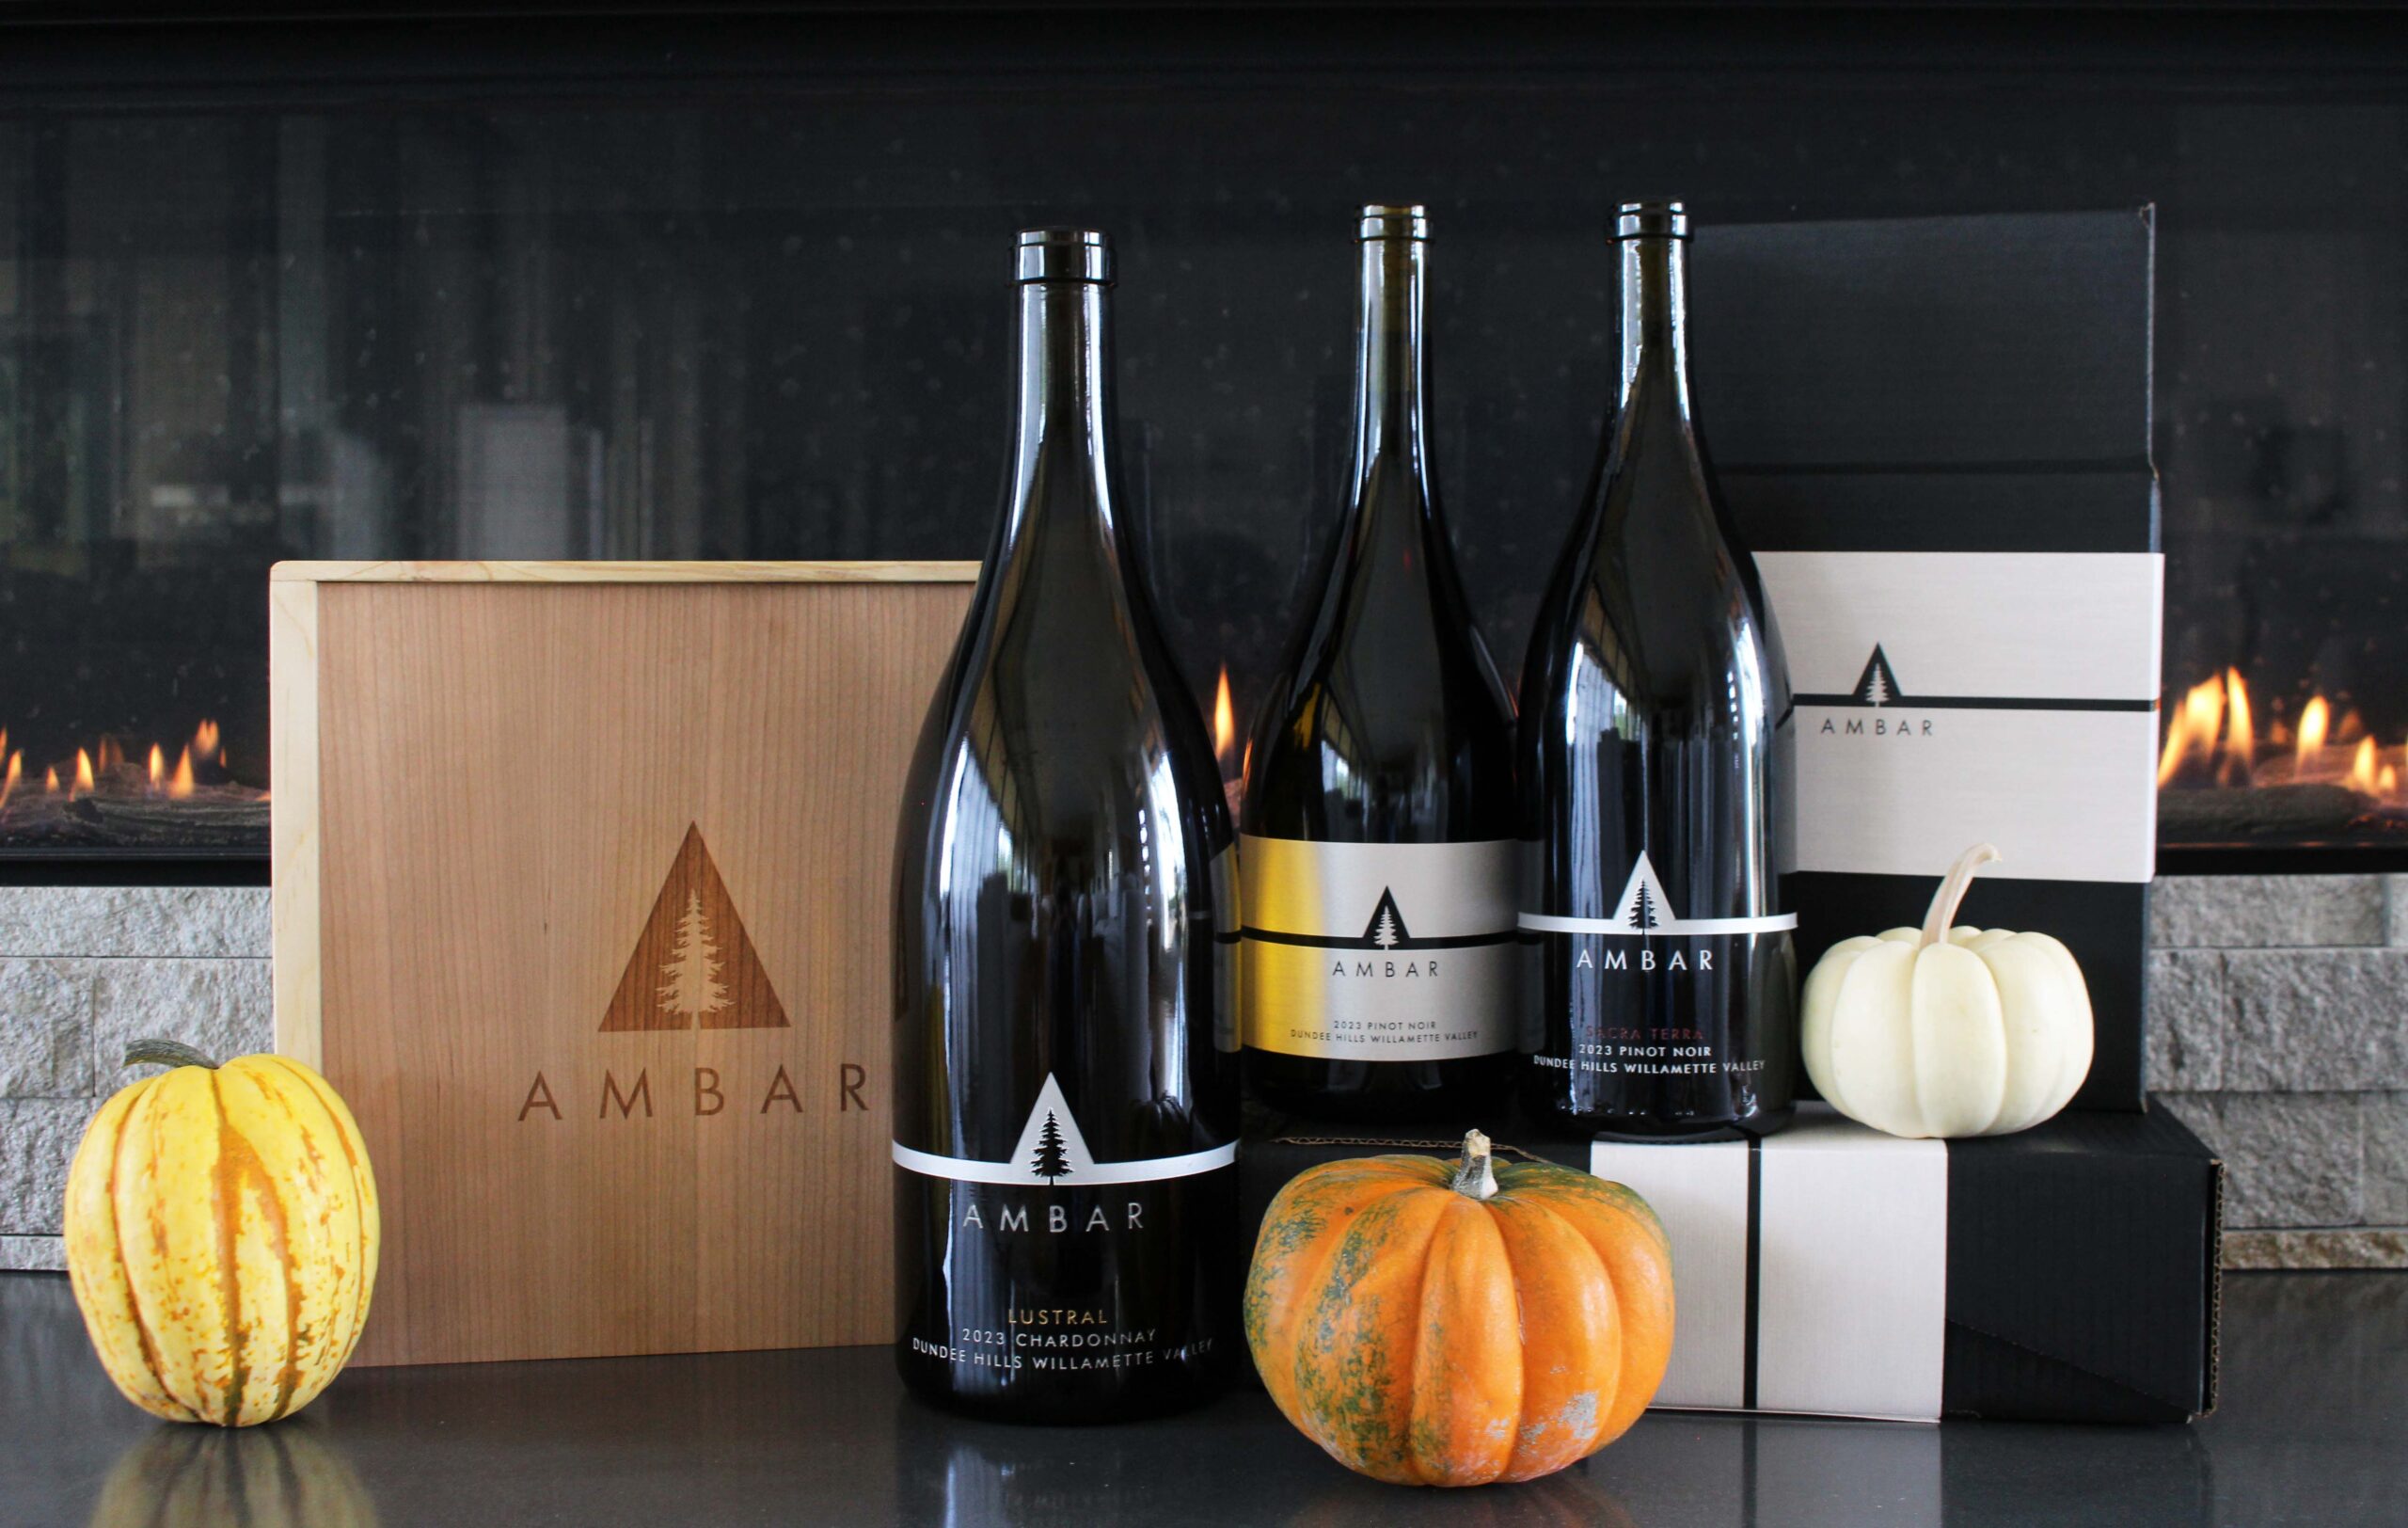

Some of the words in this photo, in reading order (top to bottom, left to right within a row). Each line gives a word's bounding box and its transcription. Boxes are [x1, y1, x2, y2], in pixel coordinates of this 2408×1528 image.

[1821, 718, 1933, 736] AMBAR
[1332, 960, 1438, 978] AMBAR
[1576, 949, 1714, 971] AMBAR
[1334, 1020, 1362, 1029] 2023
[1367, 1021, 1403, 1030] PINOT
[1408, 1020, 1436, 1029] NOIR
[1649, 1027, 1703, 1041] TERRA
[1291, 1029, 1331, 1041] DUNDEE
[1336, 1032, 1366, 1043] HILLS
[1370, 1033, 1440, 1043] WILLAMETTE
[1445, 1030, 1479, 1041] VALLEY
[1578, 1043, 1612, 1056] 2023
[1620, 1046, 1665, 1058] PINOT
[1672, 1046, 1712, 1058] NOIR
[1533, 1055, 1576, 1070] DUNDEE
[1580, 1060, 1618, 1073] HILLS
[1624, 1063, 1717, 1074] WILLAMETTE
[1723, 1059, 1766, 1073] VALLEY
[518, 1062, 868, 1122] AMBAR
[962, 1202, 1144, 1234] AMBAR
[1008, 1309, 1108, 1325] LUSTRAL
[962, 1328, 1005, 1345] 2023
[1016, 1329, 1157, 1347] CHARDONNAY
[912, 1337, 967, 1362] DUNDEE
[974, 1354, 1022, 1369] HILLS
[1033, 1351, 1154, 1370] WILLAMETTE
[1163, 1338, 1212, 1361] VALLEY
